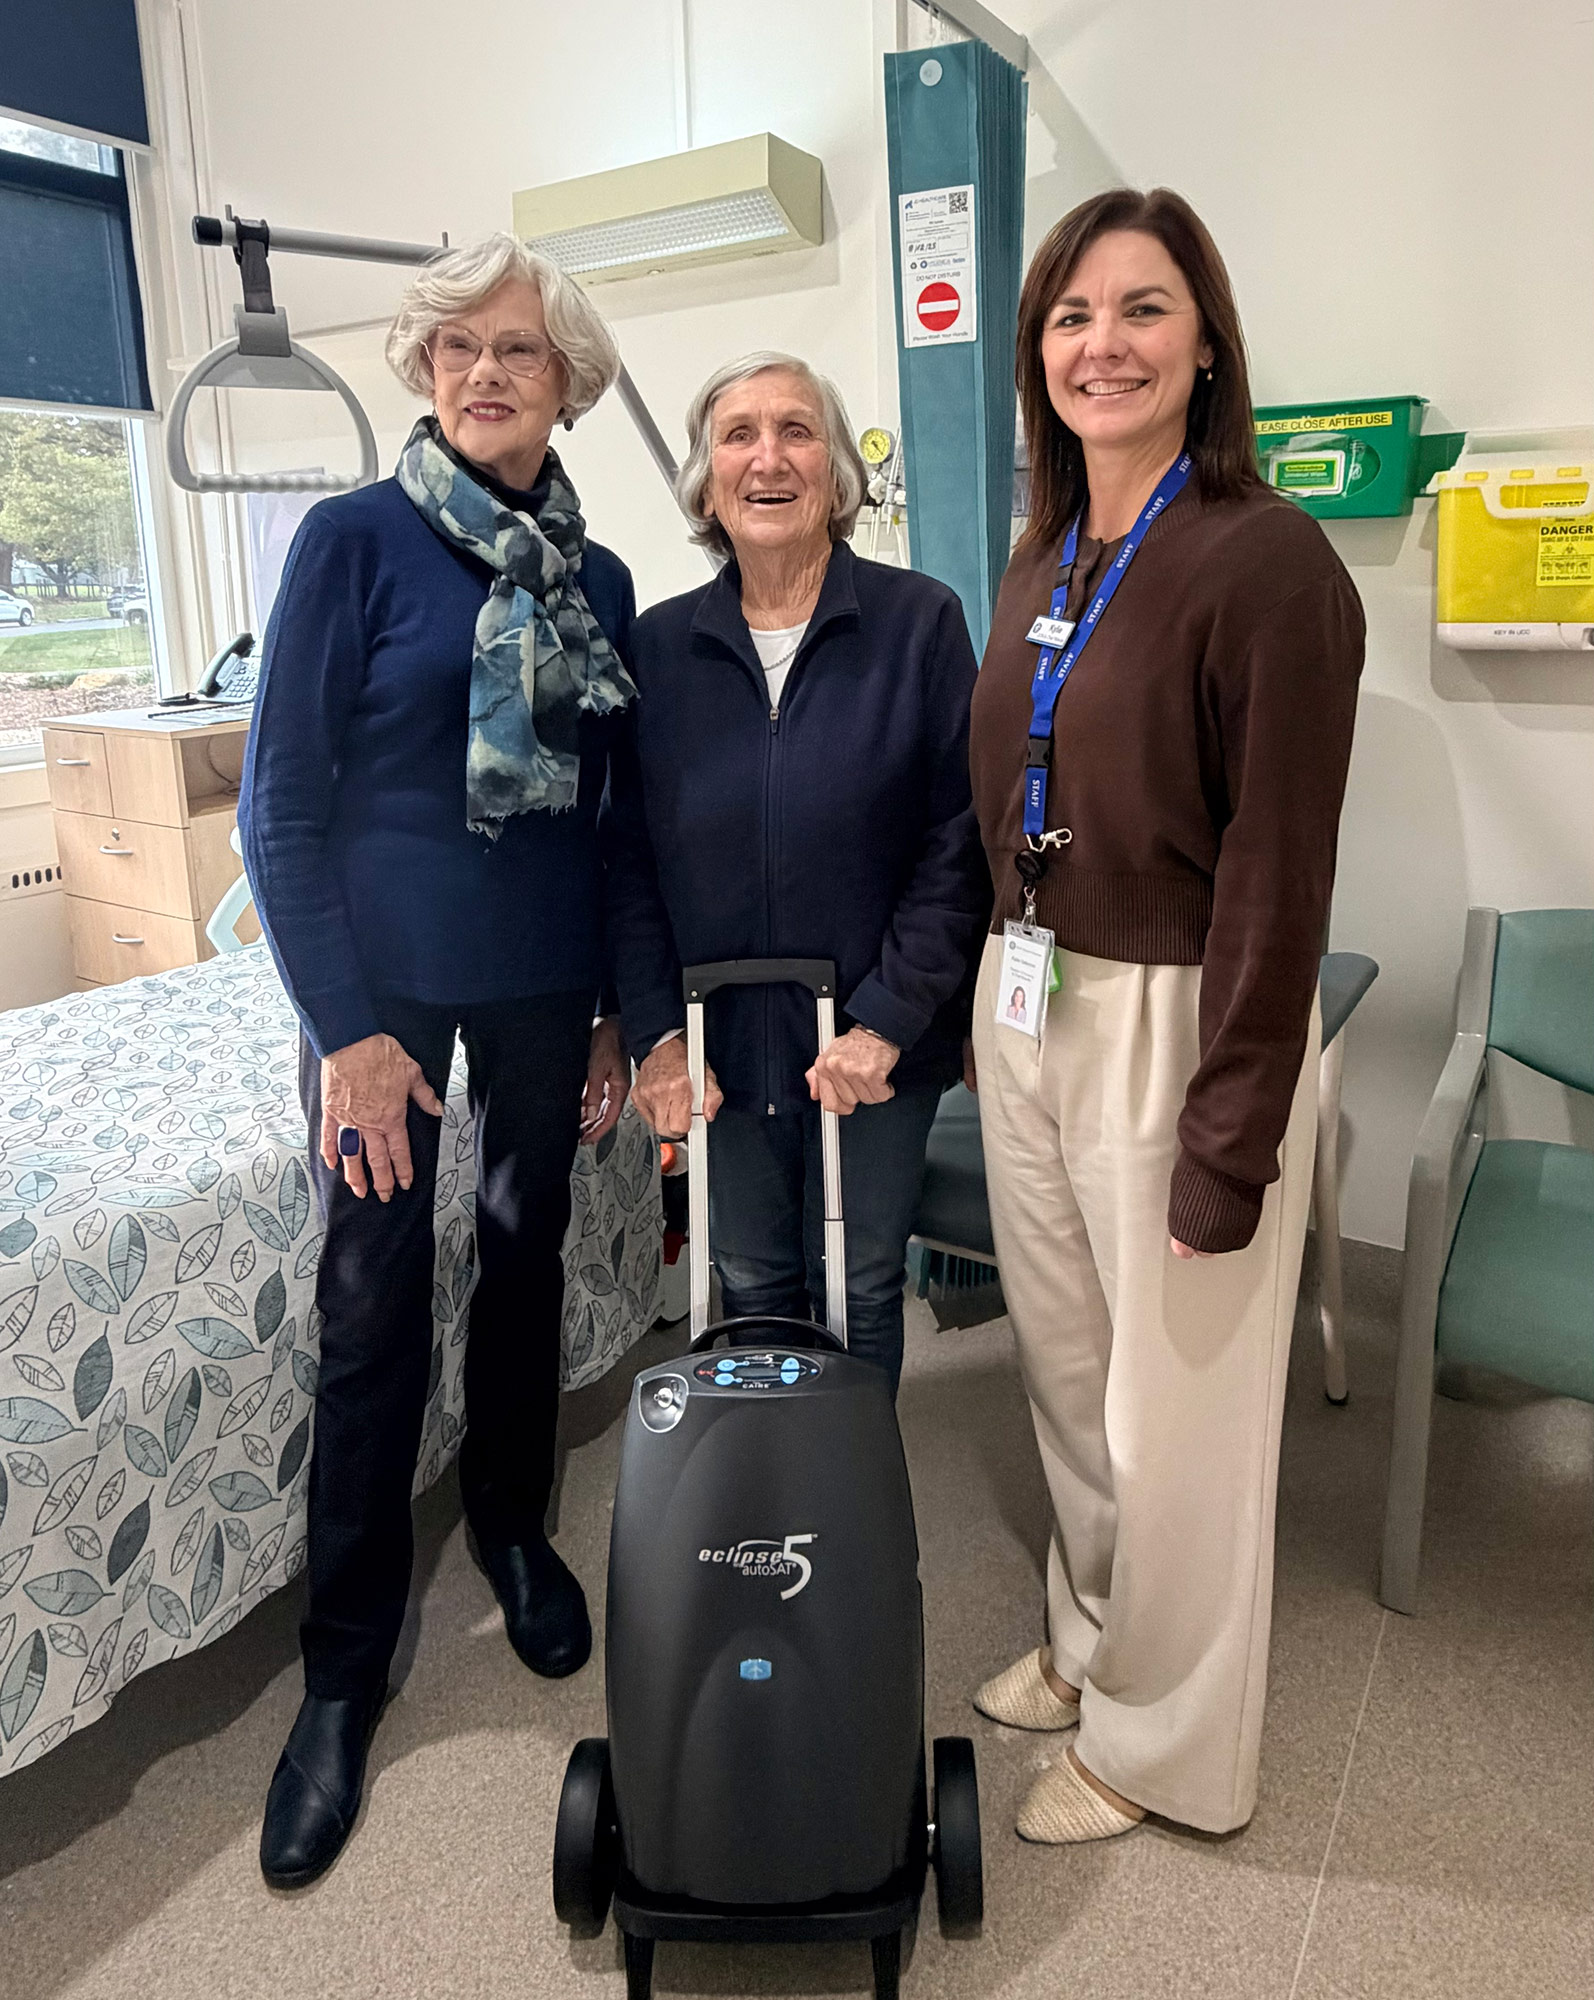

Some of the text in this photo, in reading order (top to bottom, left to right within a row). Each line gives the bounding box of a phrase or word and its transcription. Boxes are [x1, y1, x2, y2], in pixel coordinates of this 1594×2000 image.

[937, 271, 961, 279] DISTURB
[1255, 413, 1389, 433] LEASE CLOSE AFTER USE
[1145, 496, 1165, 520] STAFF
[1540, 525, 1593, 536] DANGER
[1116, 543, 1134, 568] STAFF
[1087, 597, 1104, 624] STAFF
[1038, 656, 1048, 680] STAFF
[1057, 652, 1074, 678] STAFF
[1031, 779, 1040, 808] STAFF
[698, 1534, 812, 1600] eclipse 5
